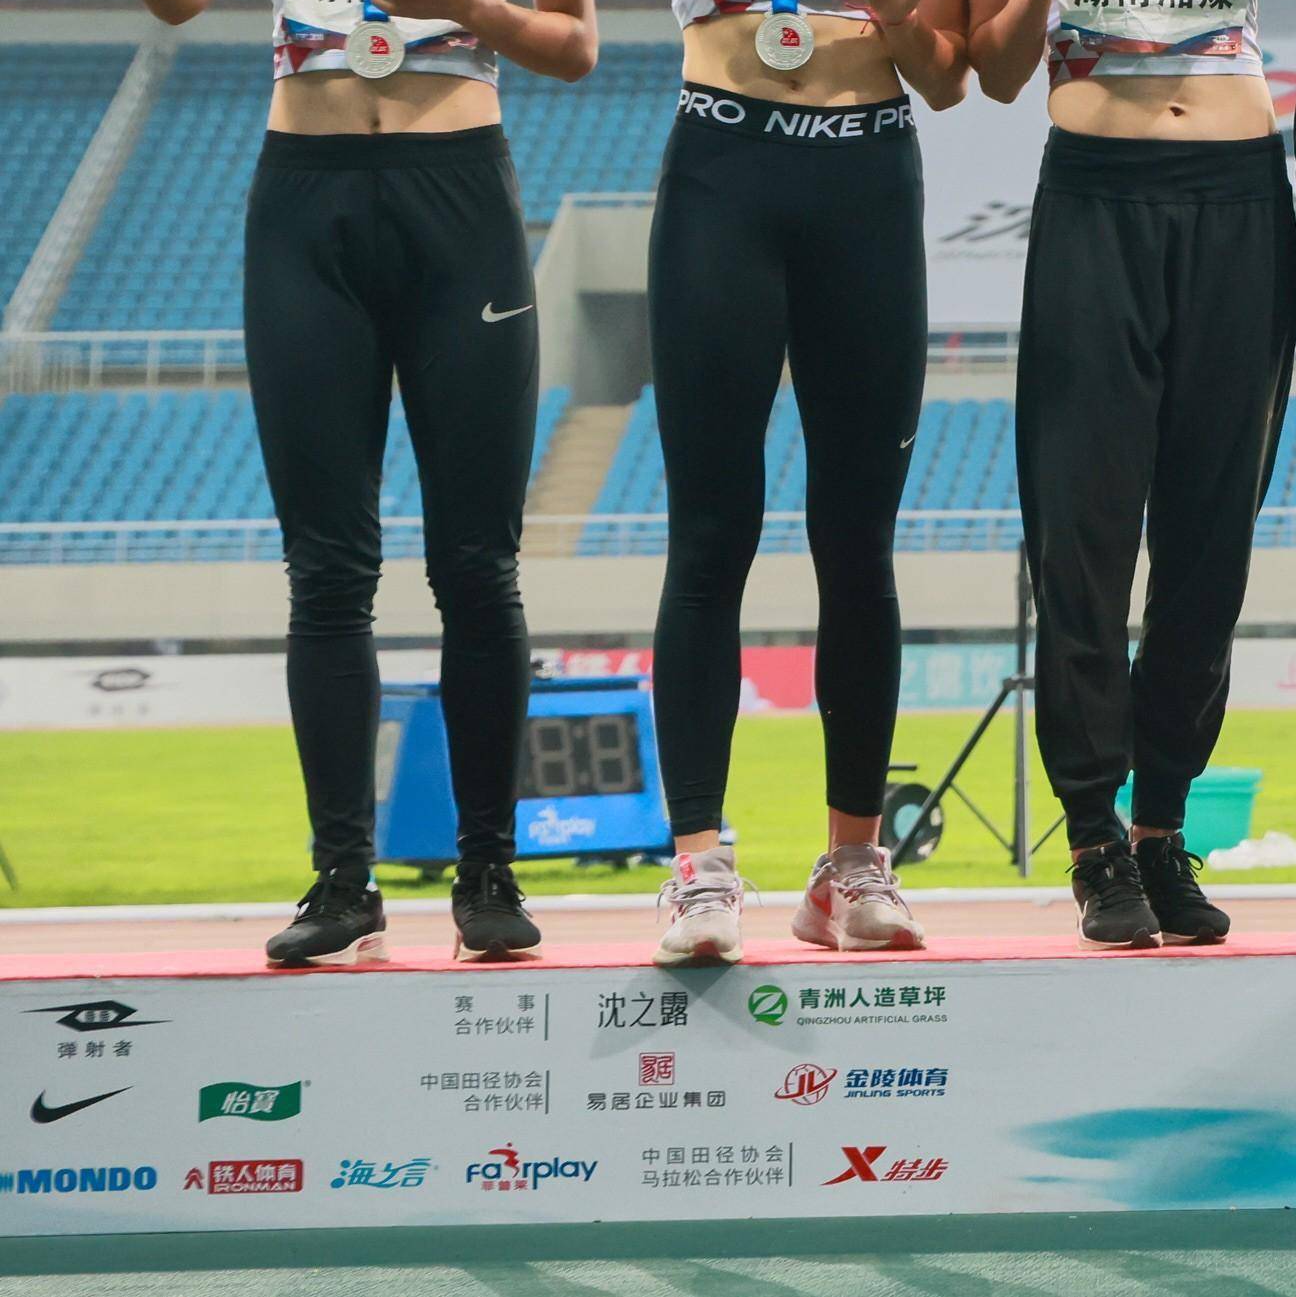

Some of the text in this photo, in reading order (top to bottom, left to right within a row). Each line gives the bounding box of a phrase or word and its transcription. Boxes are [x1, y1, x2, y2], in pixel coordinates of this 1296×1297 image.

[763, 110, 868, 139] NIKE
[873, 104, 915, 134] PR
[798, 985, 947, 1009] 青洲人造草坪
[597, 990, 690, 1029] 沈之露
[796, 1014, 948, 1026] QINGZHOU ARTIFICIAL GRASS
[453, 1016, 535, 1036] 合作伙伴
[56, 1040, 134, 1060] 弹射者
[419, 1070, 543, 1091] 中国田径协会
[843, 1067, 949, 1089] 金陵体育
[463, 1093, 543, 1113] 合作伙伴
[586, 1090, 726, 1111] 易居企业集团
[843, 1088, 946, 1099] JINLING SPORTS
[641, 1144, 784, 1166] 中国田径协会
[16, 1165, 158, 1195] MONDO
[212, 1163, 298, 1184] 铁人体育
[329, 1157, 432, 1190] 海之言
[640, 1166, 785, 1189] 马拉松合作伙伴
[213, 1181, 298, 1194] IRONMAN
